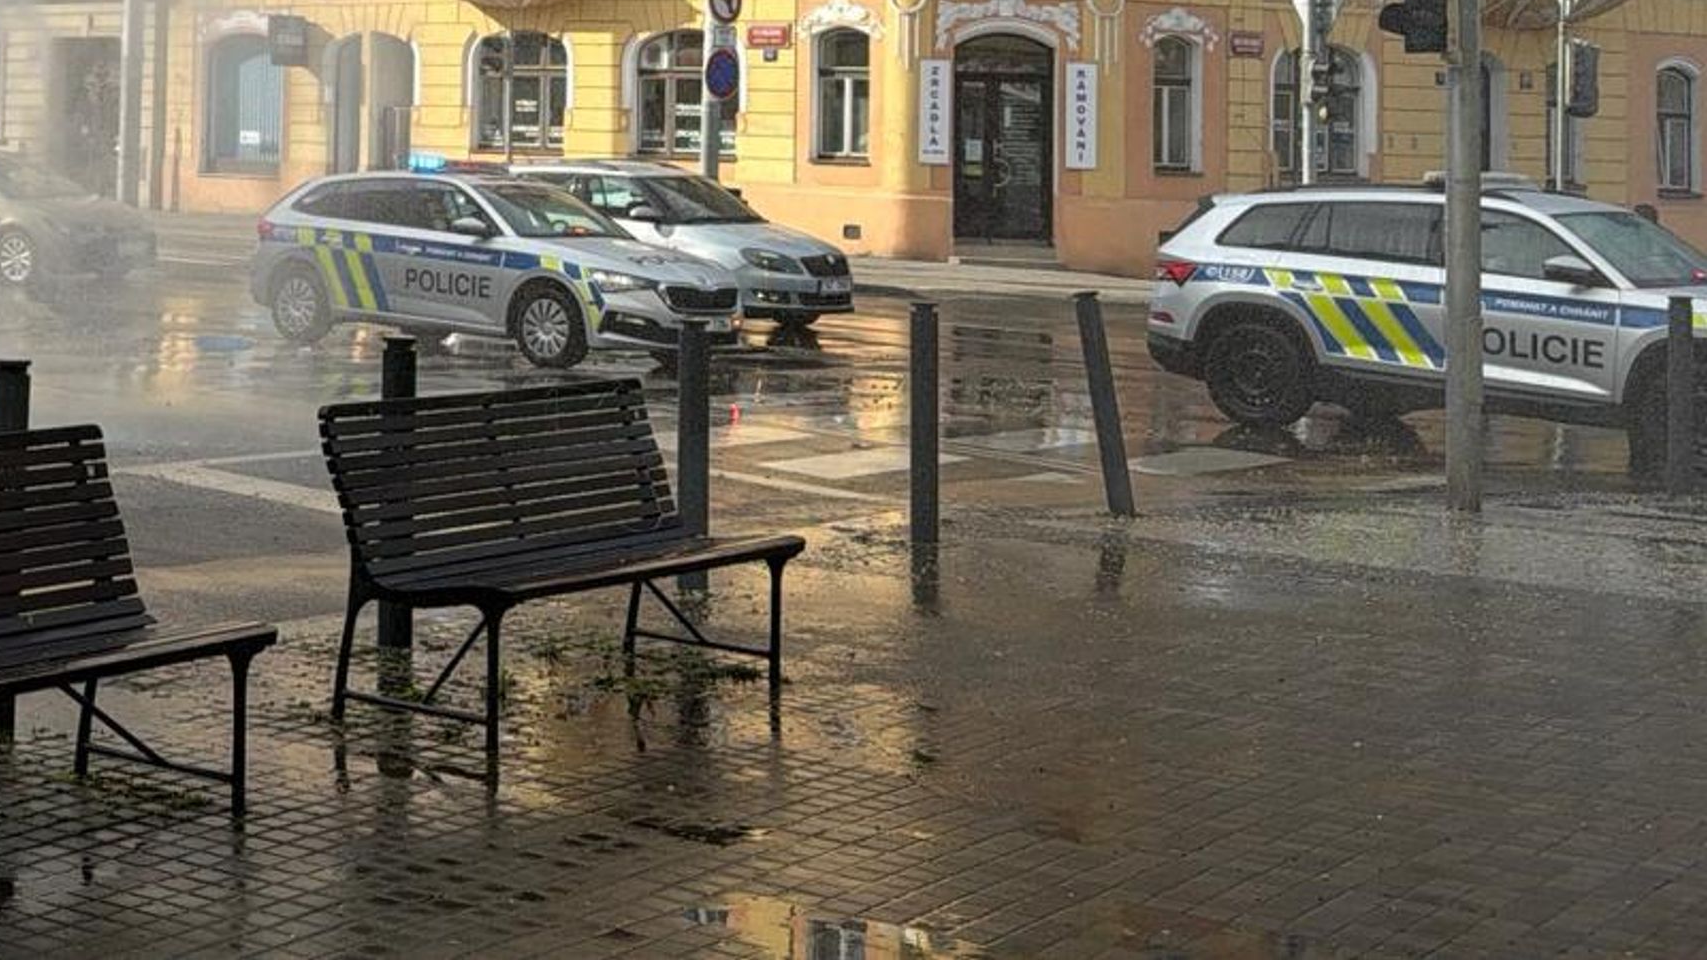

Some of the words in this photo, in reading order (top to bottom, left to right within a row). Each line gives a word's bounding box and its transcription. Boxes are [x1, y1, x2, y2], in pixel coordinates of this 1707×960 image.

[929, 66, 940, 146] ZRCADLA
[405, 268, 491, 298] POLICIE
[1482, 327, 1604, 369] OLICIE
